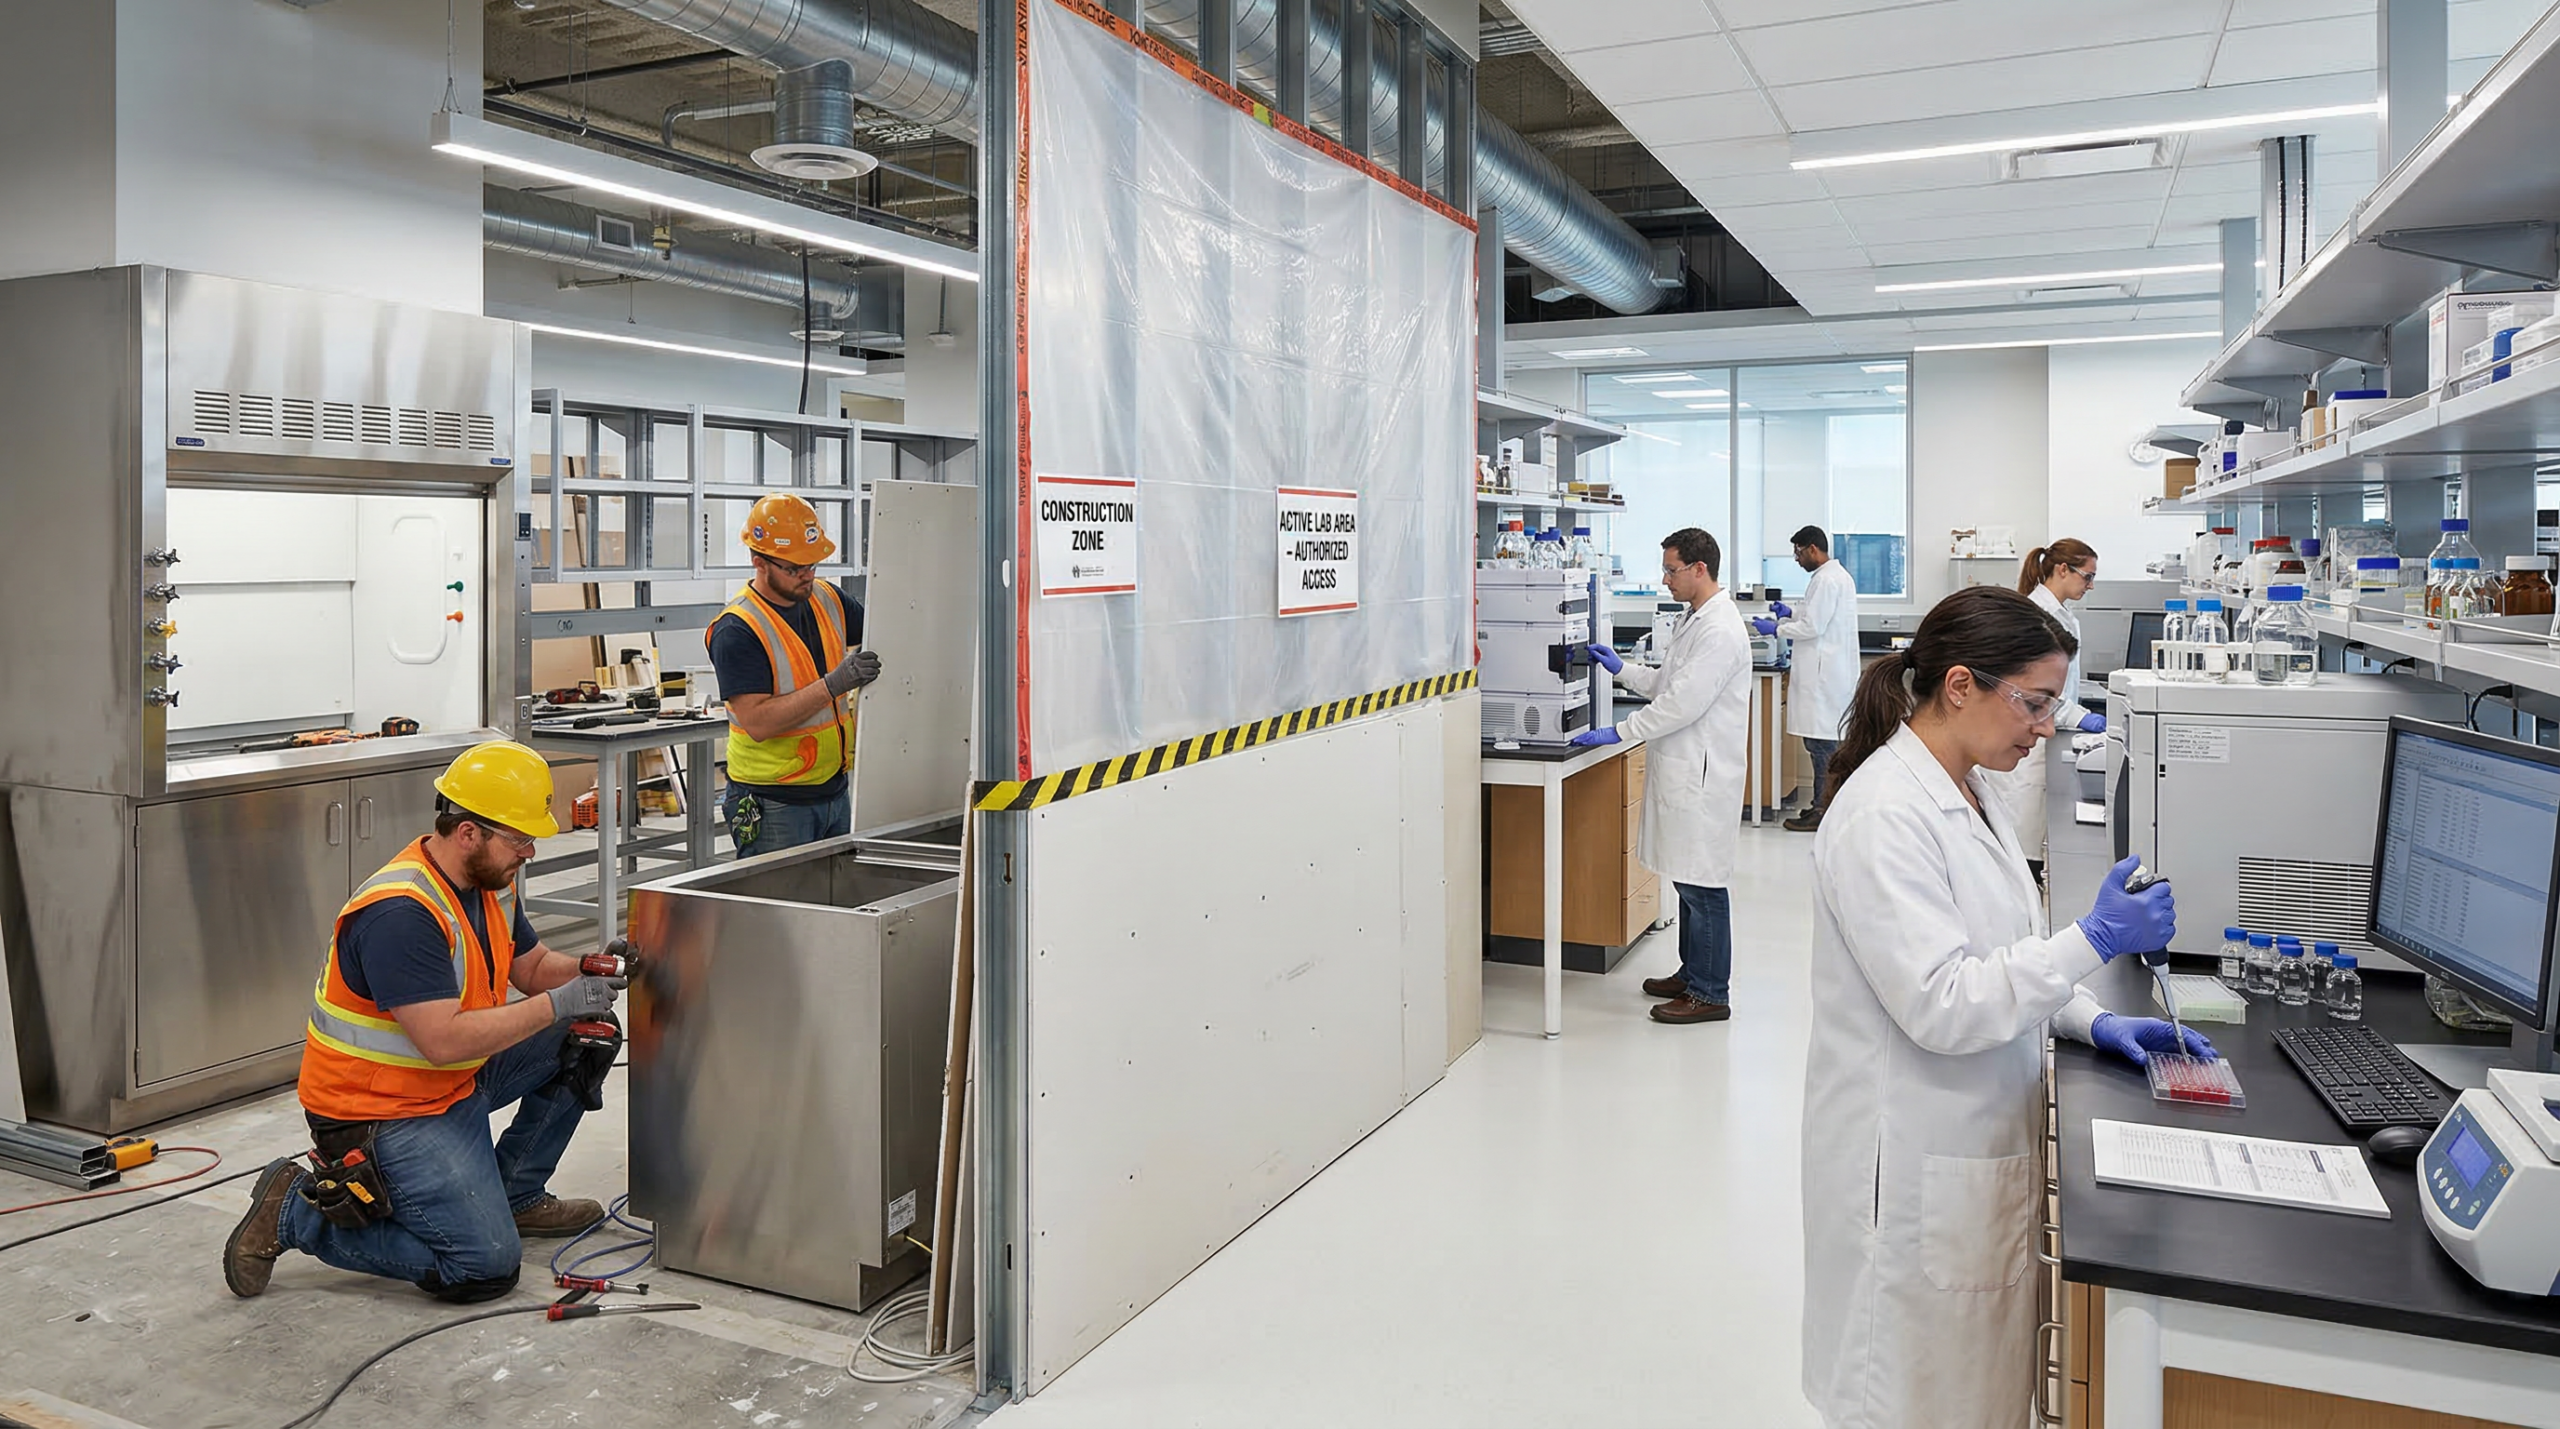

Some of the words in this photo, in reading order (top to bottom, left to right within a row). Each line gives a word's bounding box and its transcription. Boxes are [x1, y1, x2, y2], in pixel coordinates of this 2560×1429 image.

[1041, 500, 1133, 523] CONSTRUCTION
[1279, 510, 1313, 532] ACTIVE
[1315, 512, 1332, 533] LAB
[1333, 513, 1356, 533] AREA
[1071, 530, 1104, 551] ZONE
[1294, 540, 1349, 562] AUTHORIZED
[1301, 568, 1337, 590] ACCESS
